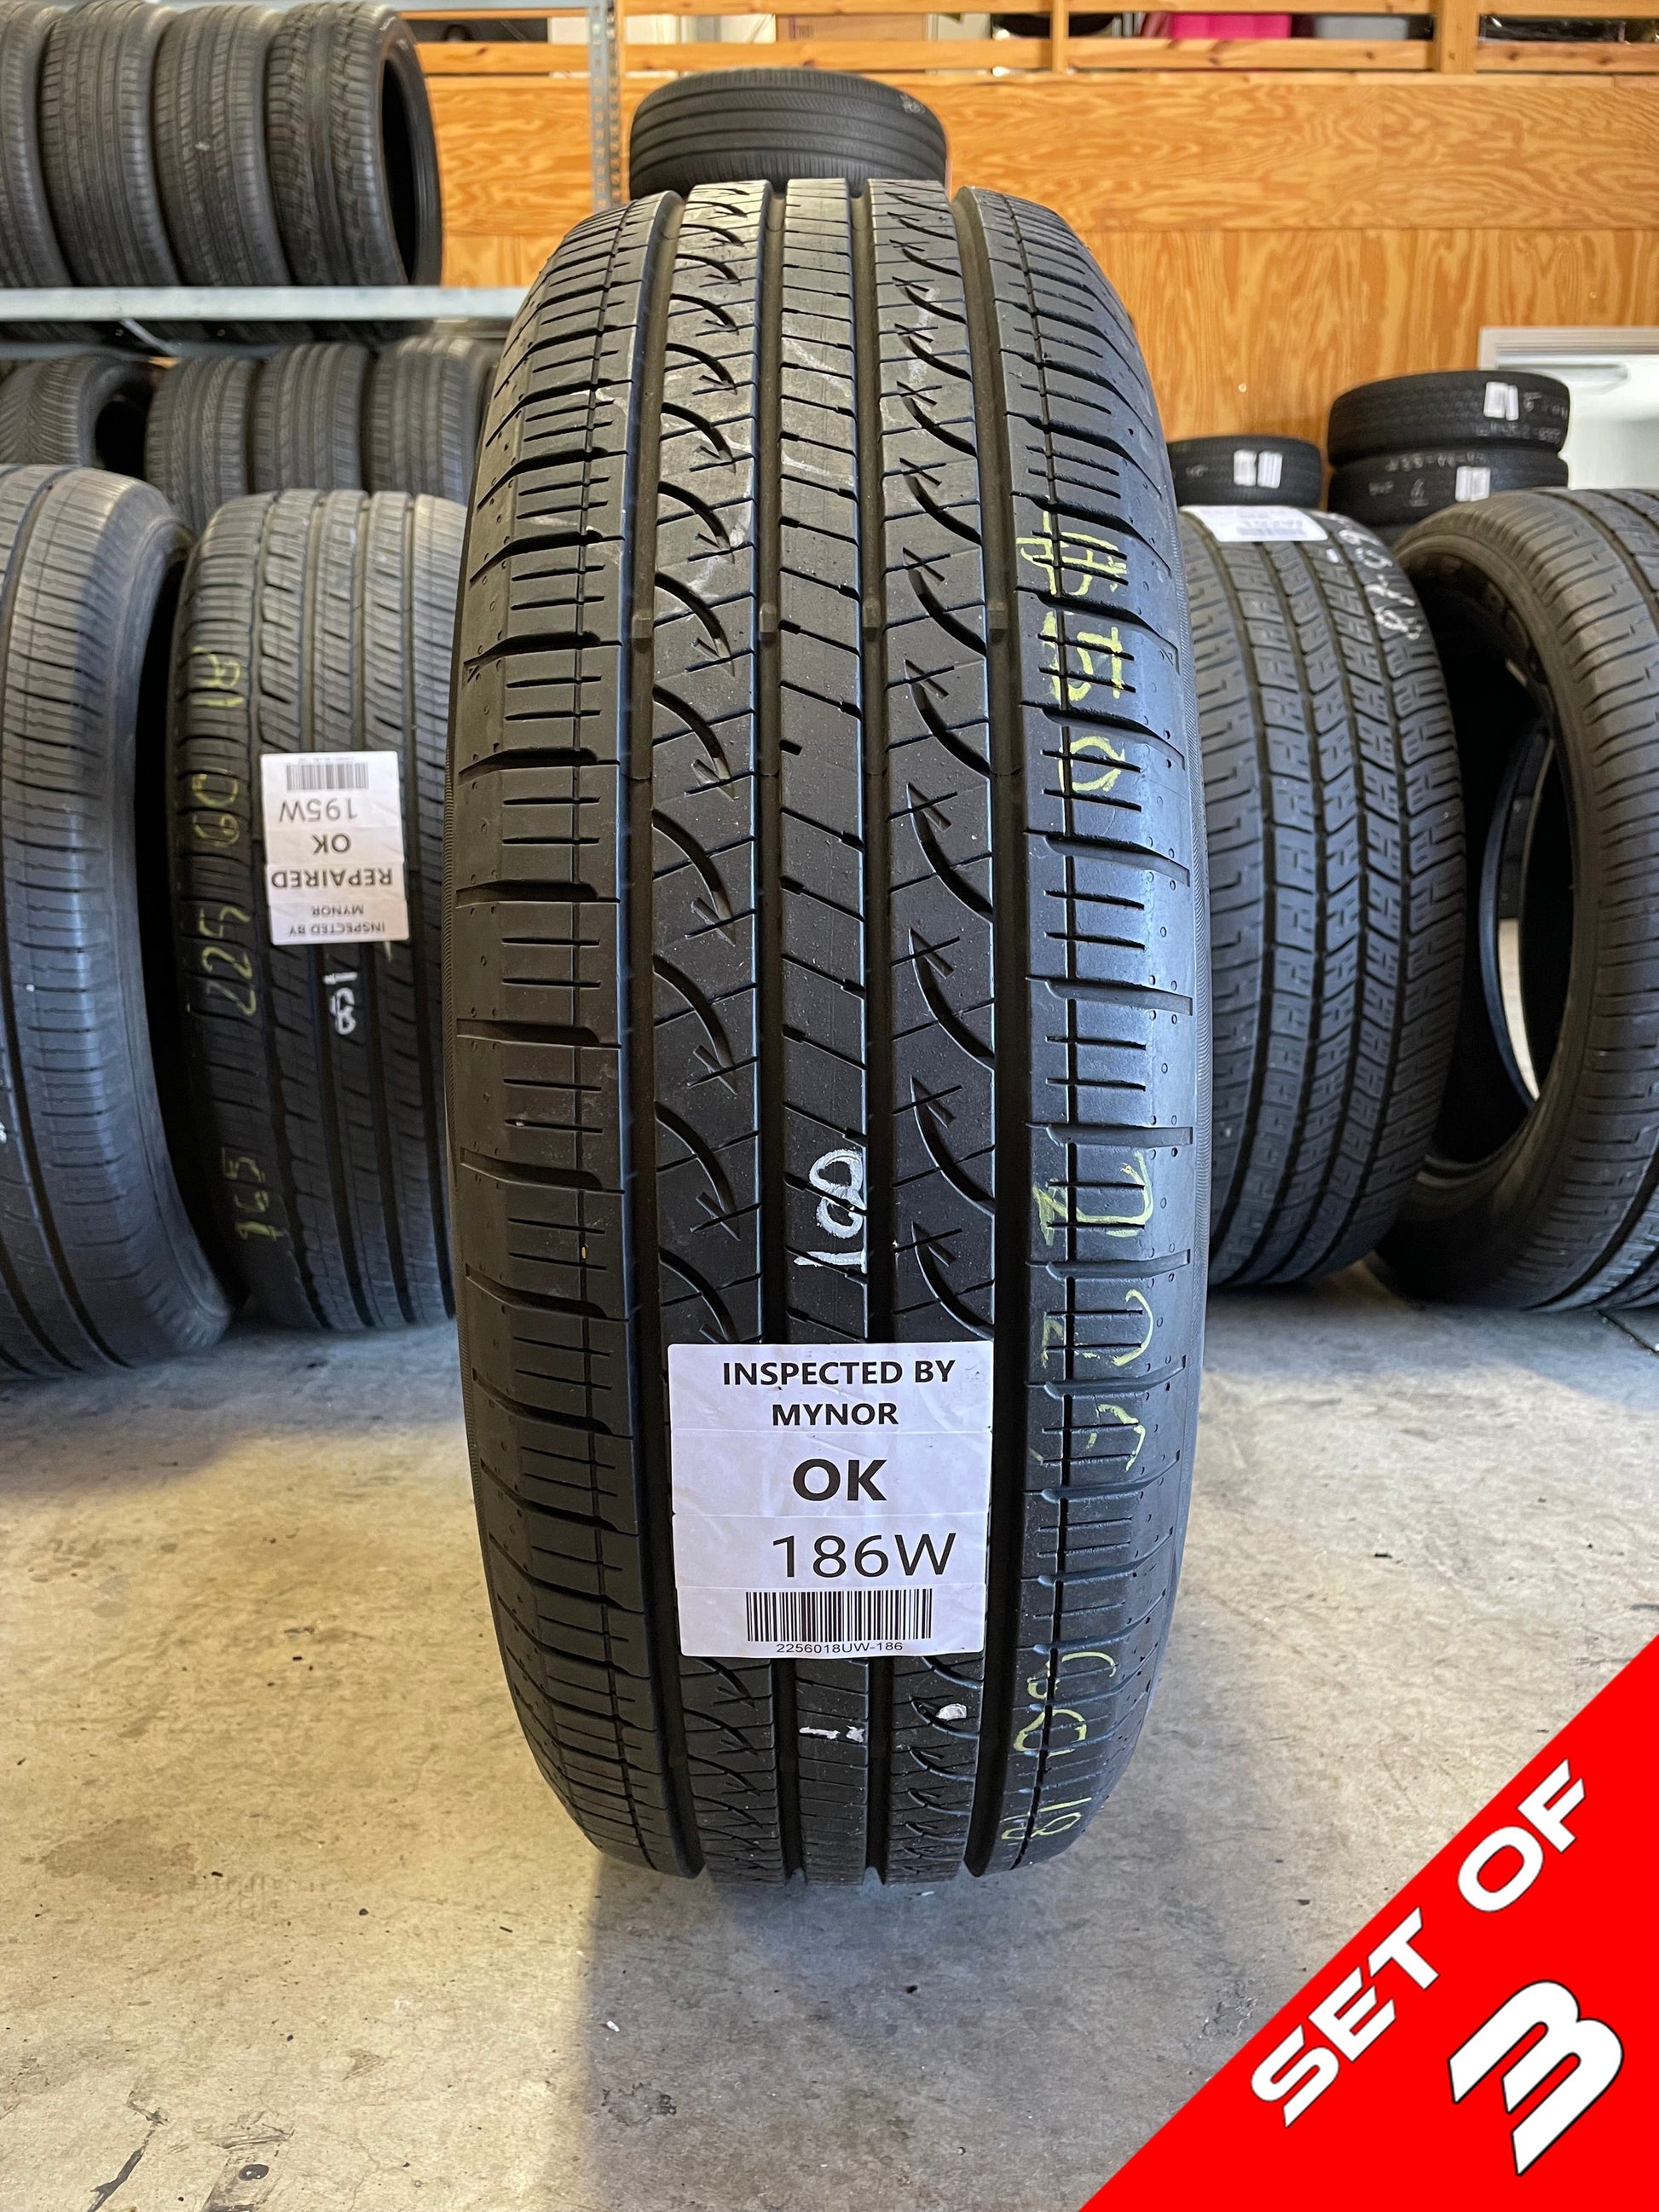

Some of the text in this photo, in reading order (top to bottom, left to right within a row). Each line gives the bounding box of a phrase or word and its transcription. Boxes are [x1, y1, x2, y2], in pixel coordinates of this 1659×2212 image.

[278, 797, 358, 823] 195W
[312, 834, 352, 854] OK
[270, 867, 394, 888] REPAIRED
[312, 904, 365, 917] MYNOR
[288, 920, 386, 937] INSPECTED BY
[793, 1148, 866, 1268] 18
[723, 1360, 956, 1386] INSPECTED BY
[772, 1402, 899, 1426] MYNOR
[793, 1458, 887, 1502] OK
[772, 1533, 957, 1578] 186W
[776, 1639, 904, 1654] 2256018UW-186
